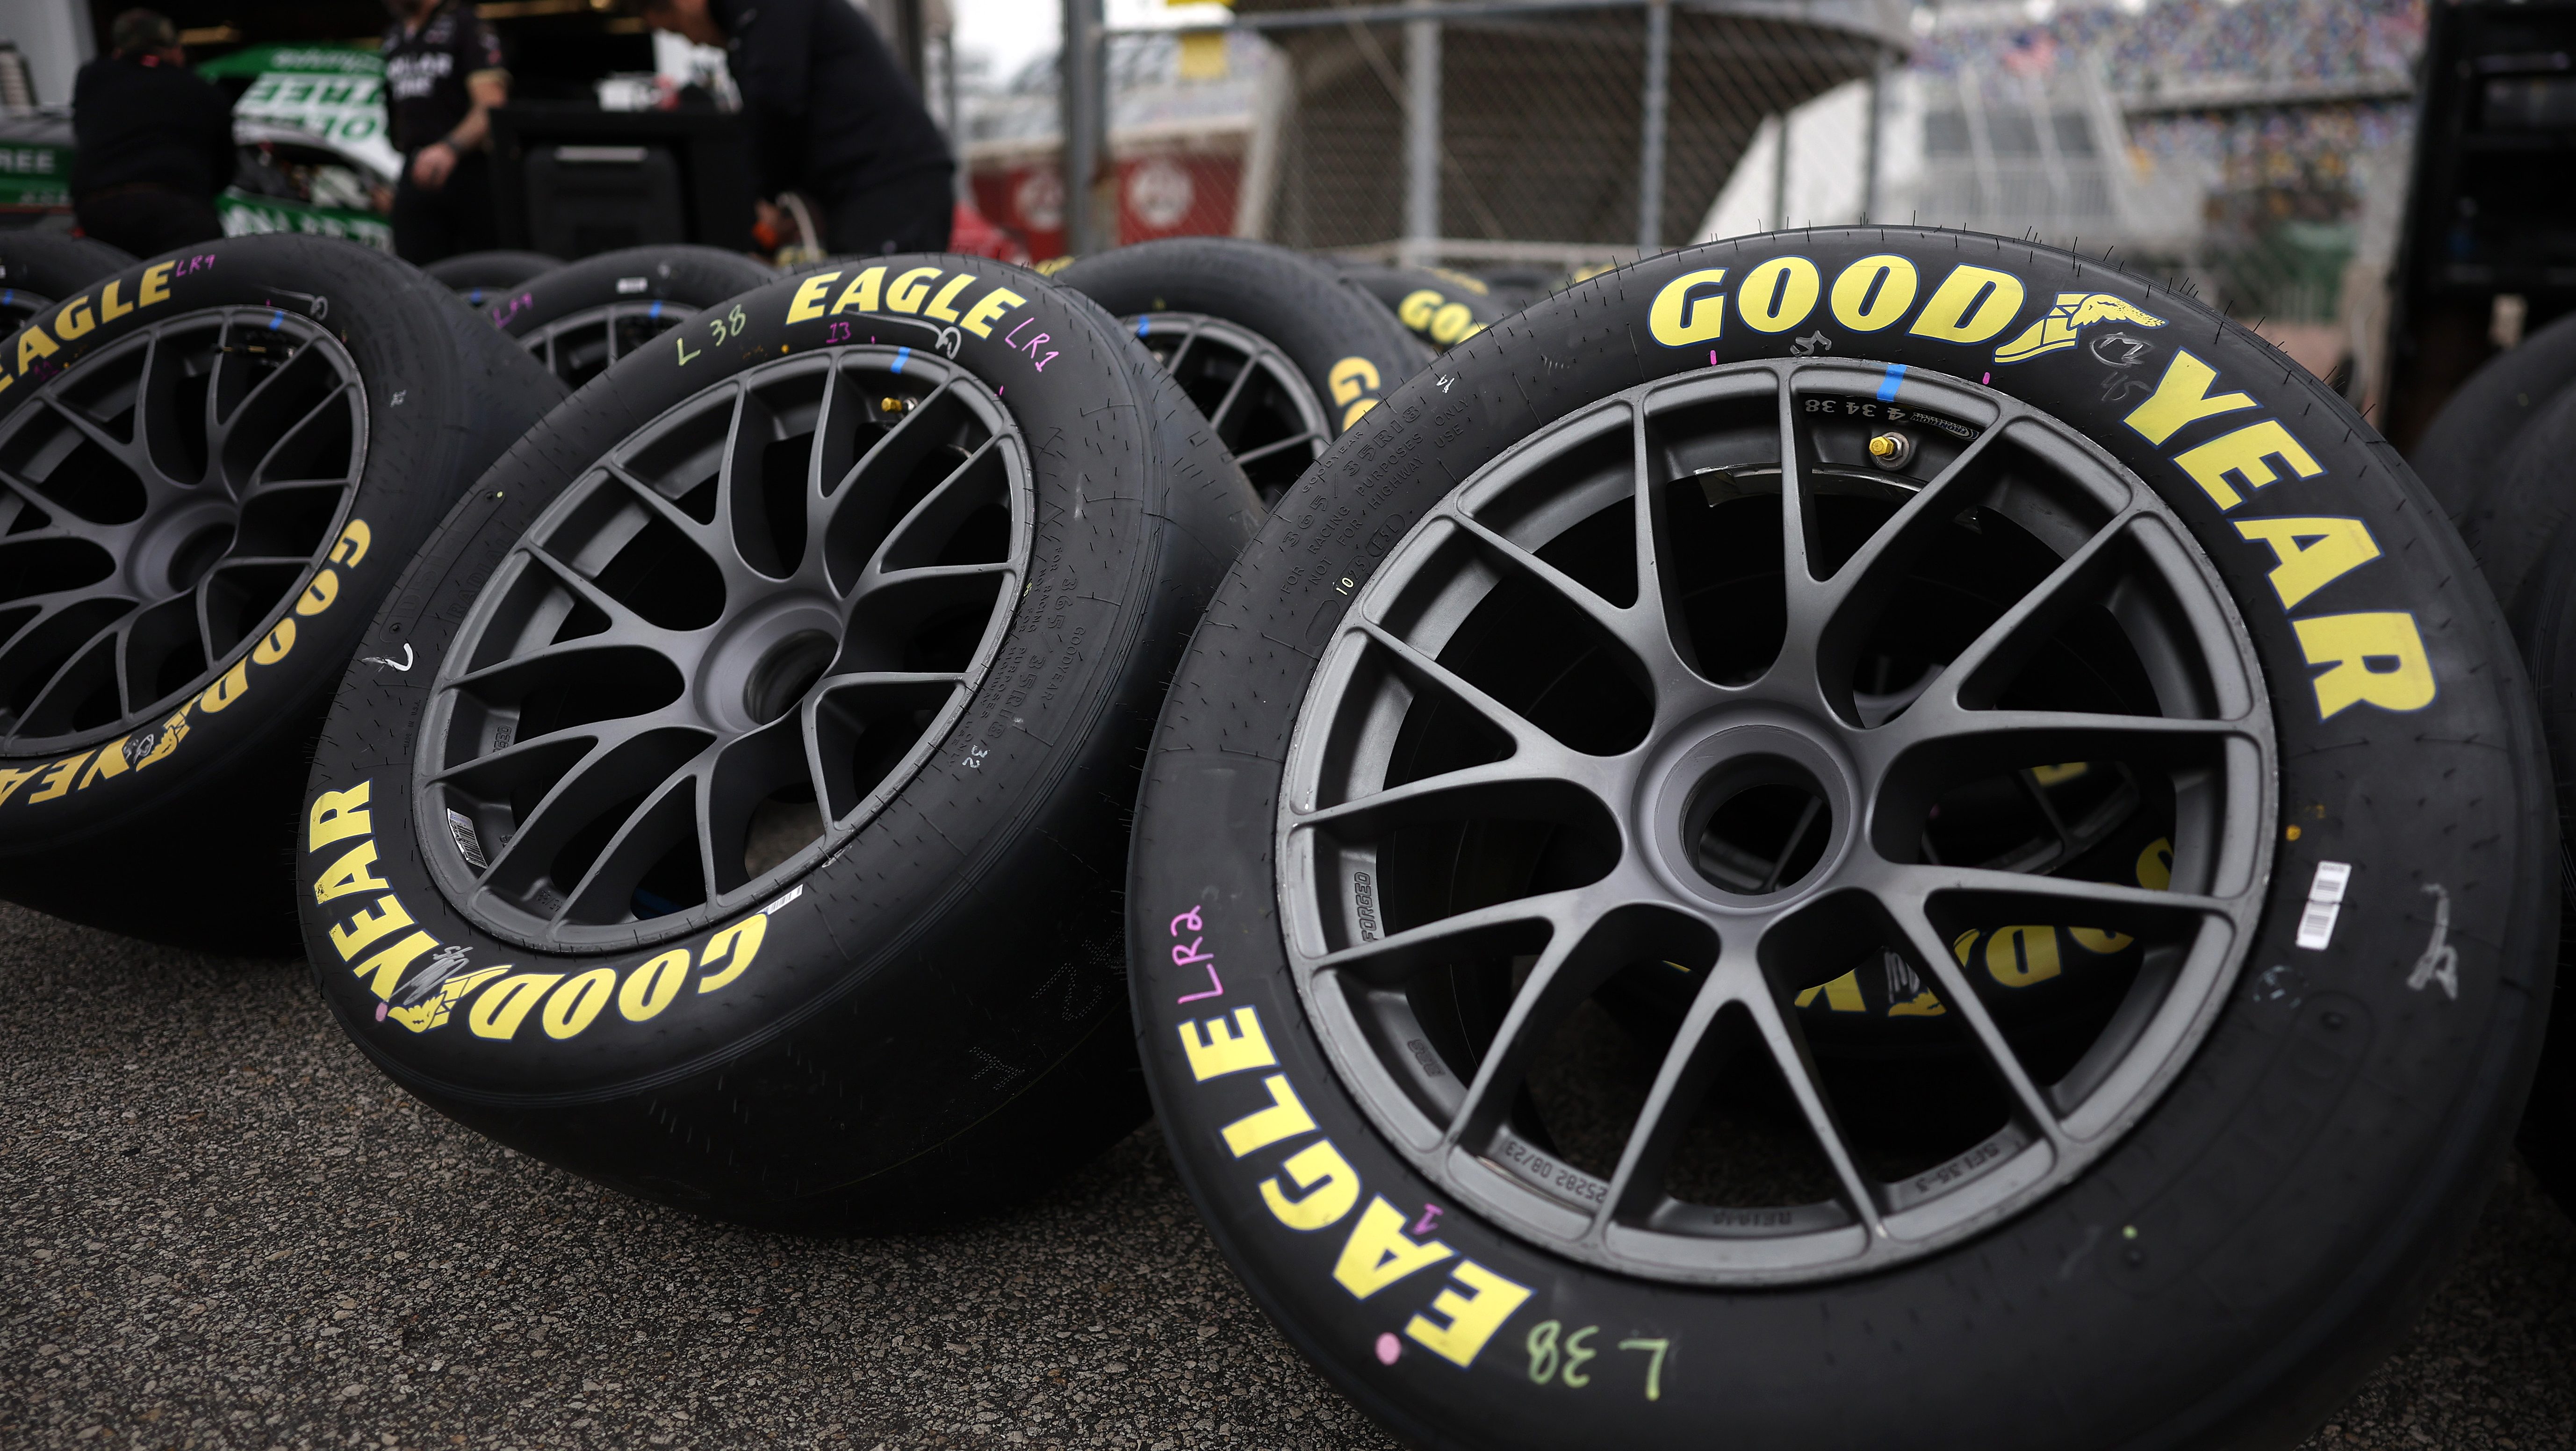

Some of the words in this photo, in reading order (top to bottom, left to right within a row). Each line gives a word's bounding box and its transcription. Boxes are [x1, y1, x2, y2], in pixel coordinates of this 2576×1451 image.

[676, 338, 701, 366] L
[710, 303, 747, 347] 38
[786, 266, 1029, 340] EAGLE
[1647, 253, 2027, 349] GOOD
[1004, 317, 1059, 372] LR1
[1804, 399, 1837, 413] 38
[1846, 402, 1877, 417] 34
[1281, 565, 1304, 594] FOR
[1307, 505, 1351, 554] RACING
[1356, 432, 1423, 496] PURPOSES
[1434, 397, 1469, 426] ONLY
[1302, 431, 1363, 493] GOODYEAR
[1308, 555, 1332, 585] NOT
[1336, 518, 1363, 546] FOR
[1368, 454, 1425, 509] HIGHWAY
[1433, 423, 1464, 448] USE
[2119, 345, 2440, 725] YEAR
[446, 538, 515, 619] RADIAL
[1034, 568, 1047, 592] NOT
[1050, 546, 1063, 573] FOR
[200, 518, 372, 714] GOOD
[1018, 606, 1034, 632] FOR
[1029, 584, 1052, 632] RACING
[980, 646, 1027, 718] PURPOSES
[1040, 627, 1086, 701] GOODYEAR
[403, 732, 412, 748] MADE
[493, 725, 512, 753] GED
[309, 777, 444, 1002] YEAR
[1354, 871, 1378, 942] FORGED
[468, 912, 769, 1042] GOOD
[1170, 905, 1224, 1005] LR2
[1175, 1004, 1539, 1371] EAGLE
[1505, 1140, 1554, 1179] 08/23
[1525, 1318, 1601, 1390] 38
[1617, 1338, 1669, 1402] L
